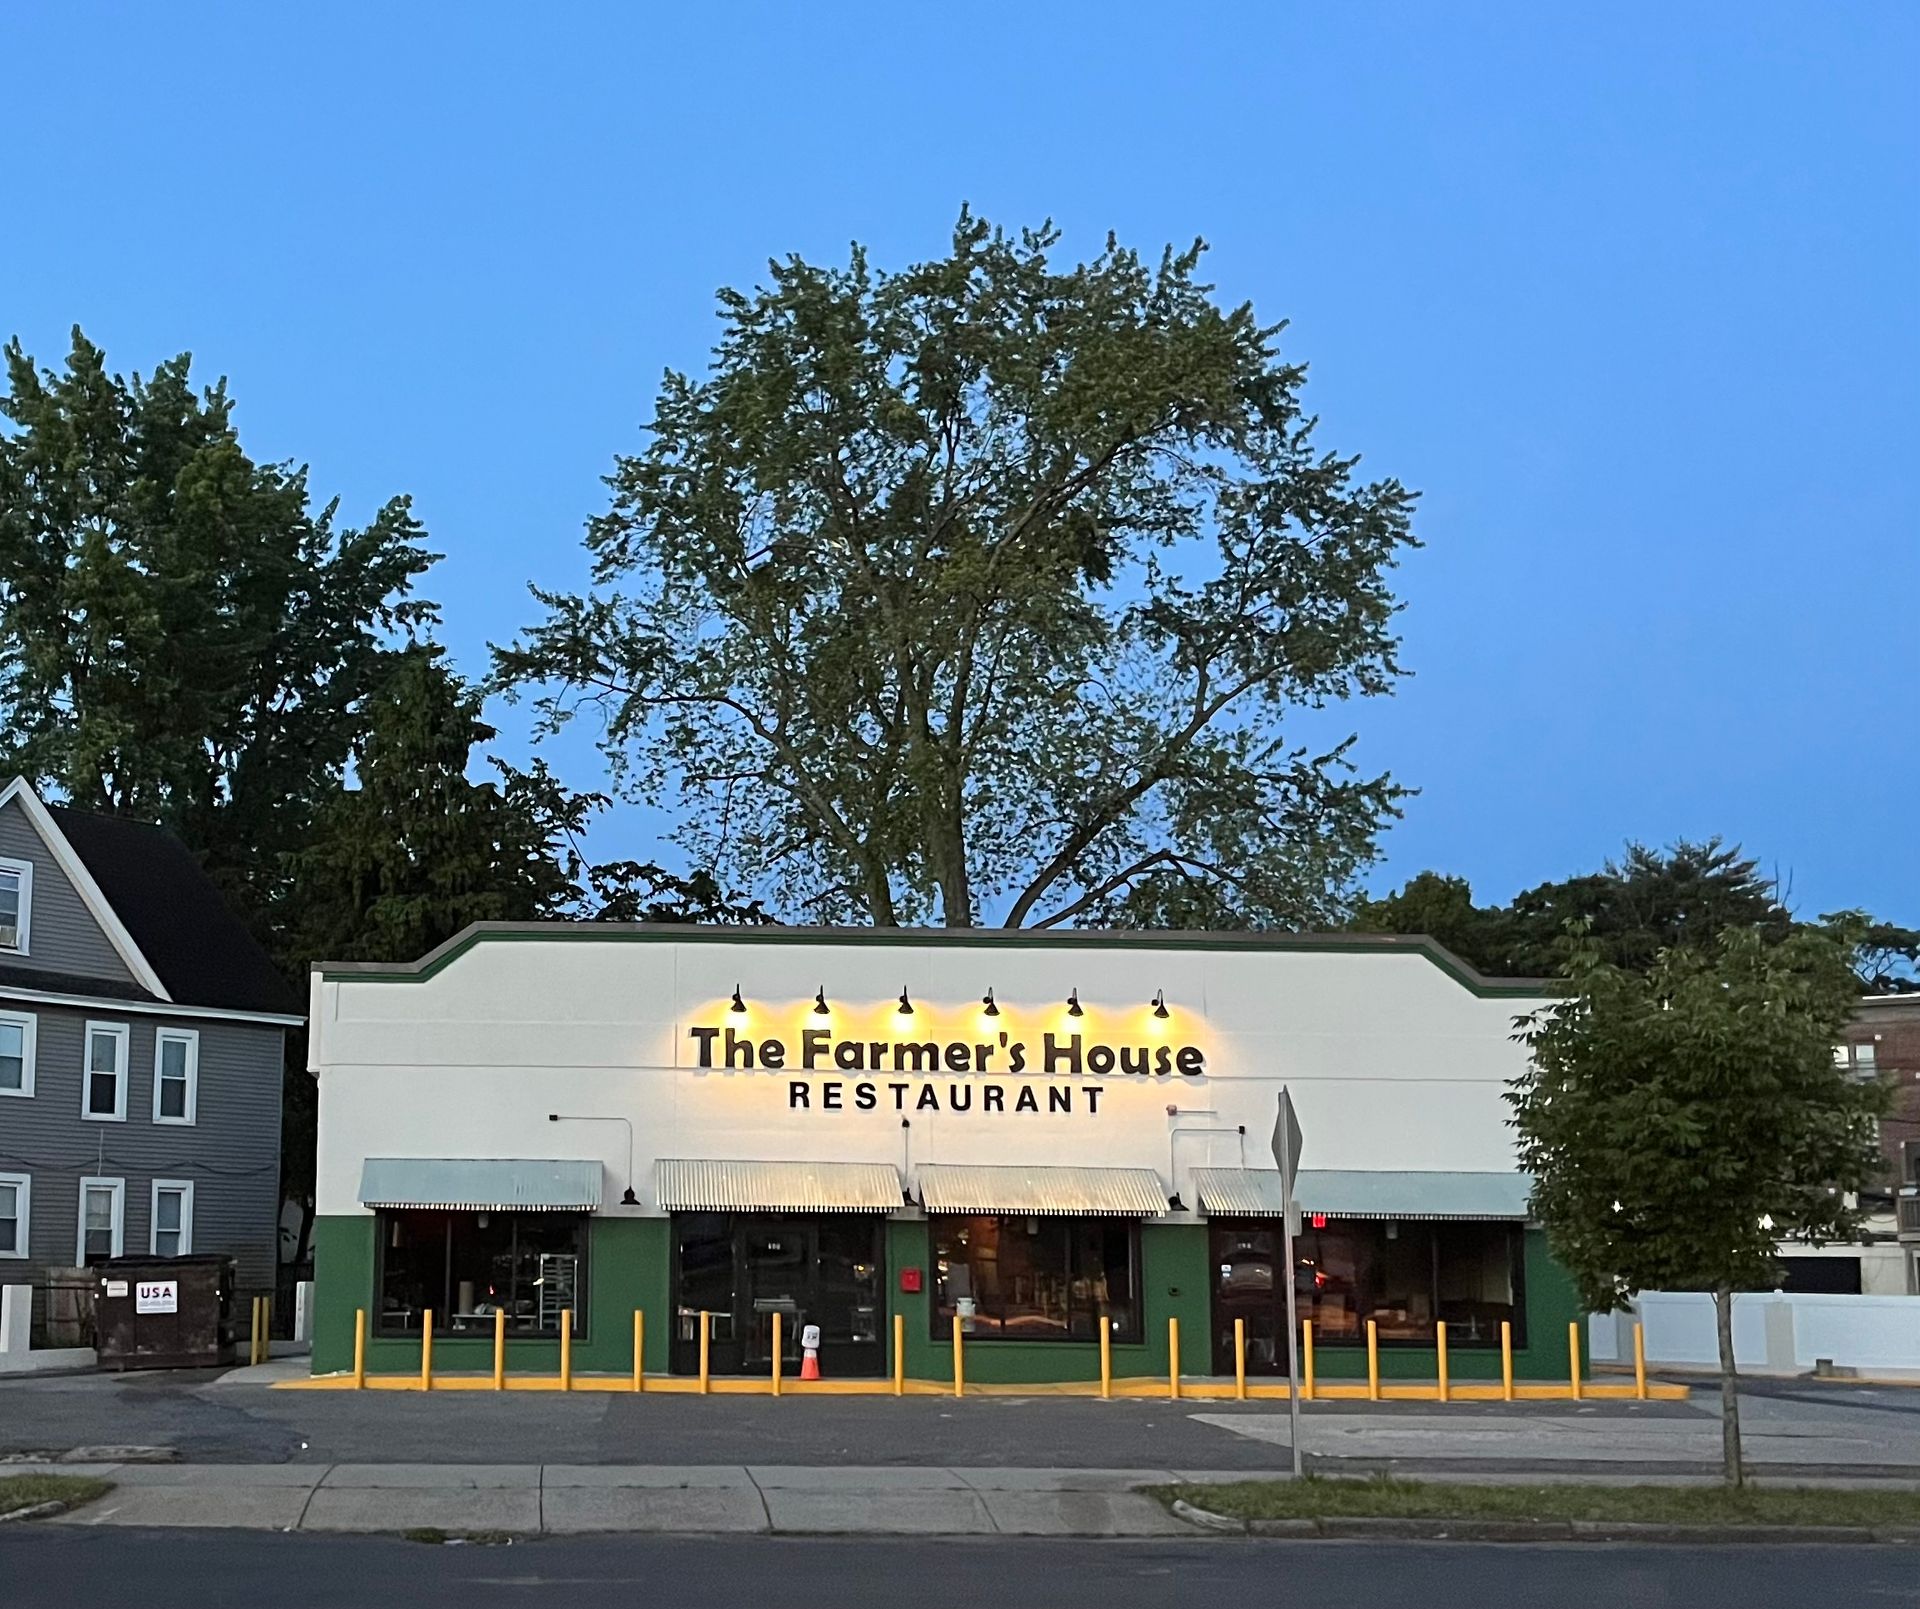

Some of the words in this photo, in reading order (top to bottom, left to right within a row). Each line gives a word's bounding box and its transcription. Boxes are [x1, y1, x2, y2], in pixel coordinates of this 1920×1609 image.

[690, 1027, 785, 1069] The
[802, 1029, 1026, 1073] Farmer's
[1044, 1032, 1204, 1076] House
[789, 1081, 1104, 1113] RESTAURANT
[141, 1287, 172, 1299] USA
